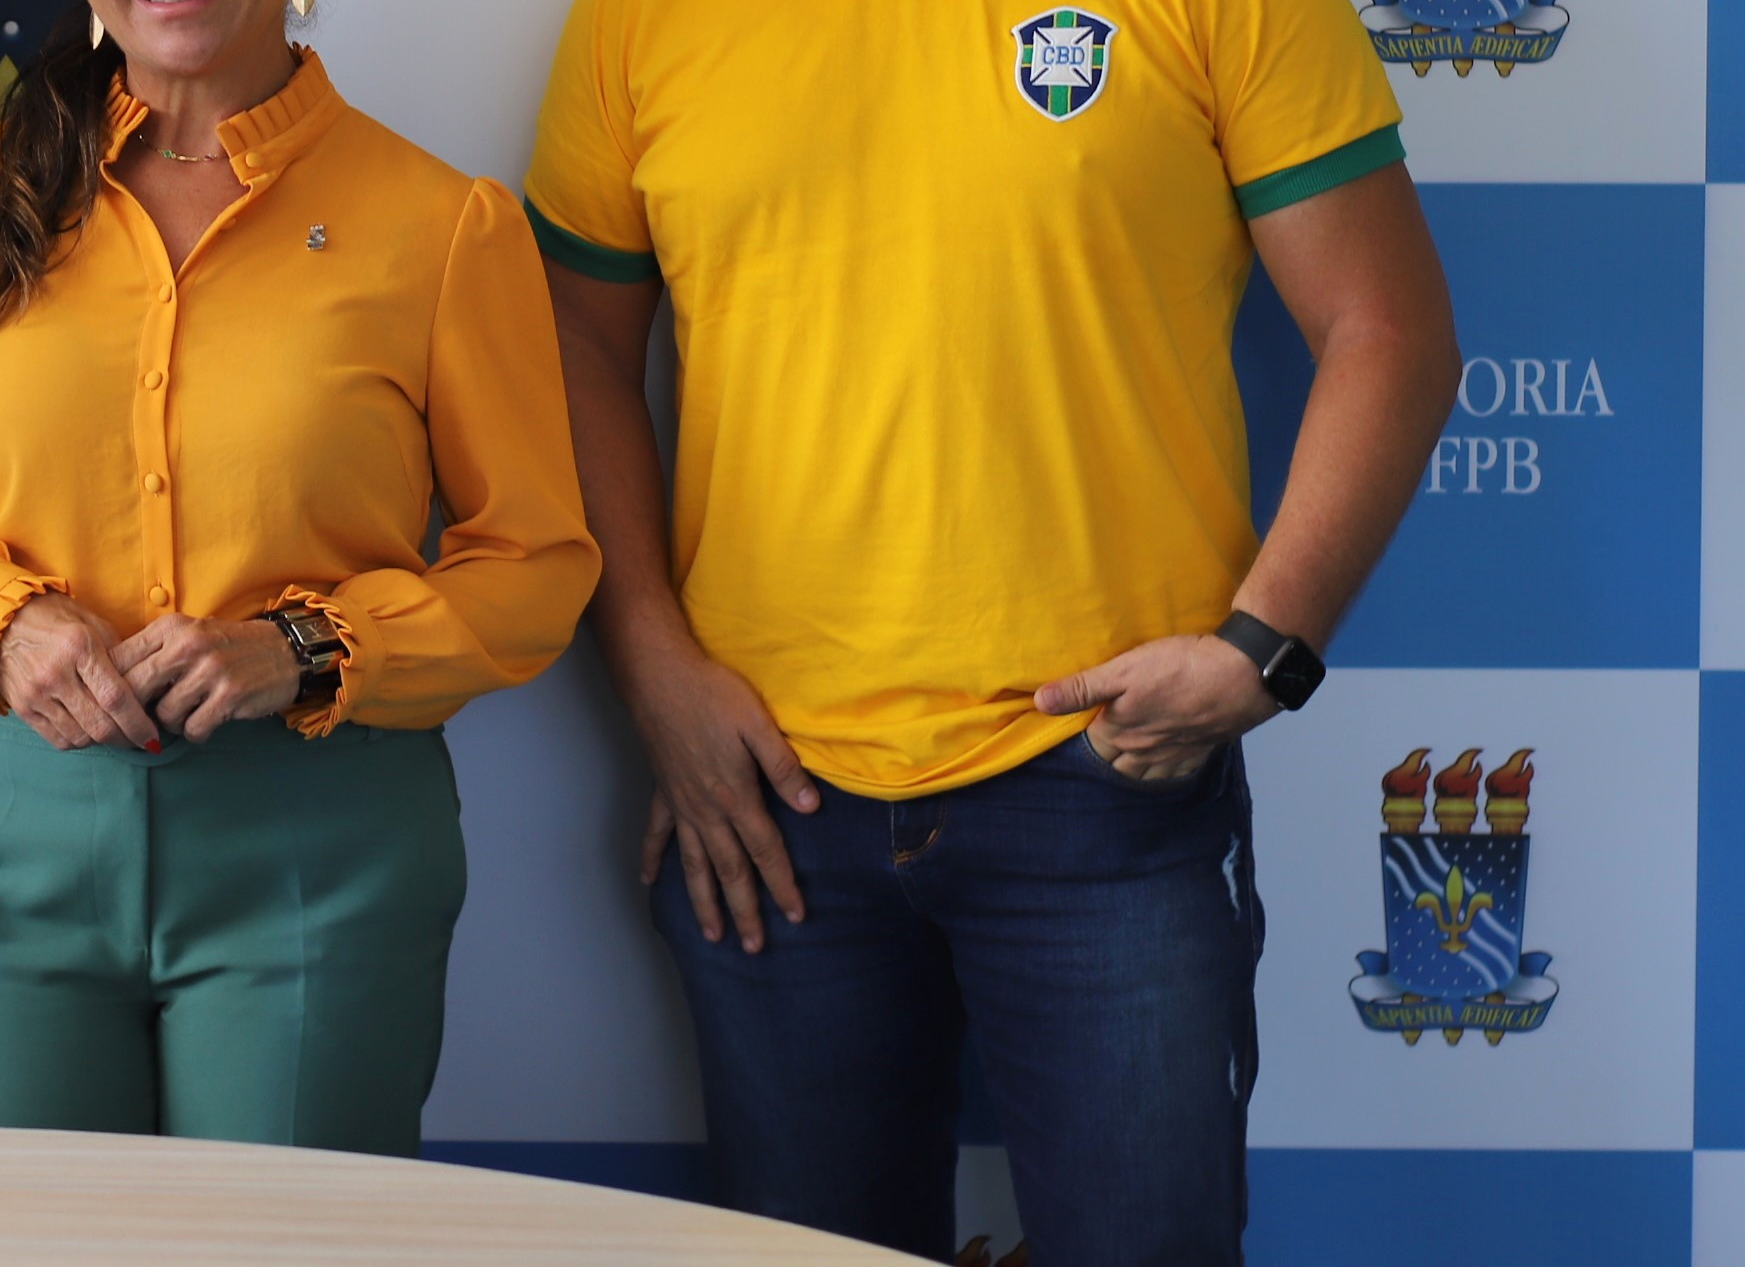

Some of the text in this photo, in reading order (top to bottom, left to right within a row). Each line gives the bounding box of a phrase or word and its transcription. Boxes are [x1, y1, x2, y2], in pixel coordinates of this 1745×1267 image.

[1043, 46, 1085, 65] CBD
[1374, 36, 1463, 58] SAPIENTIA
[1462, 358, 1614, 416] ORIA
[1428, 437, 1542, 494] FPB
[1364, 1006, 1453, 1026] SAPIENTIA
